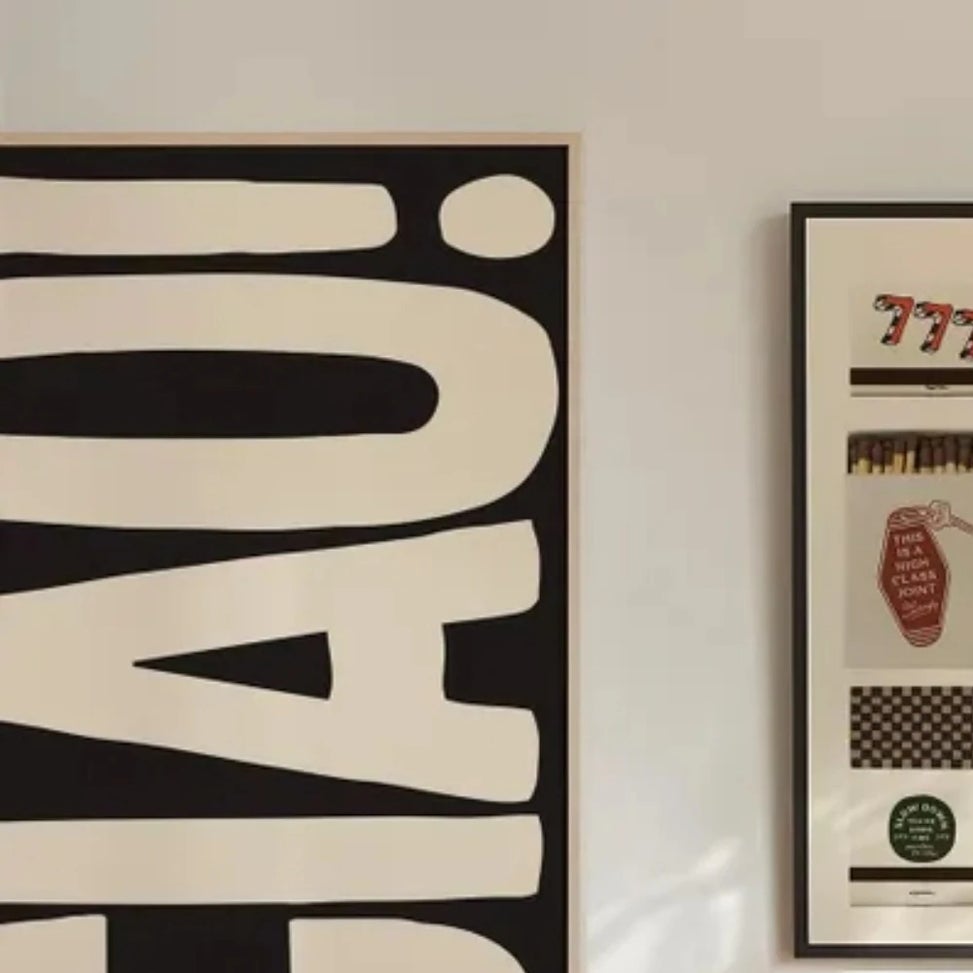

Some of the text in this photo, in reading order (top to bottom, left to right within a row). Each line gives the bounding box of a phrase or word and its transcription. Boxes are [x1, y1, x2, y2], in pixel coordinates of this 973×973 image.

[893, 530, 924, 546] THIS
[891, 569, 937, 587] CLASS
[898, 582, 937, 599] JOINT
